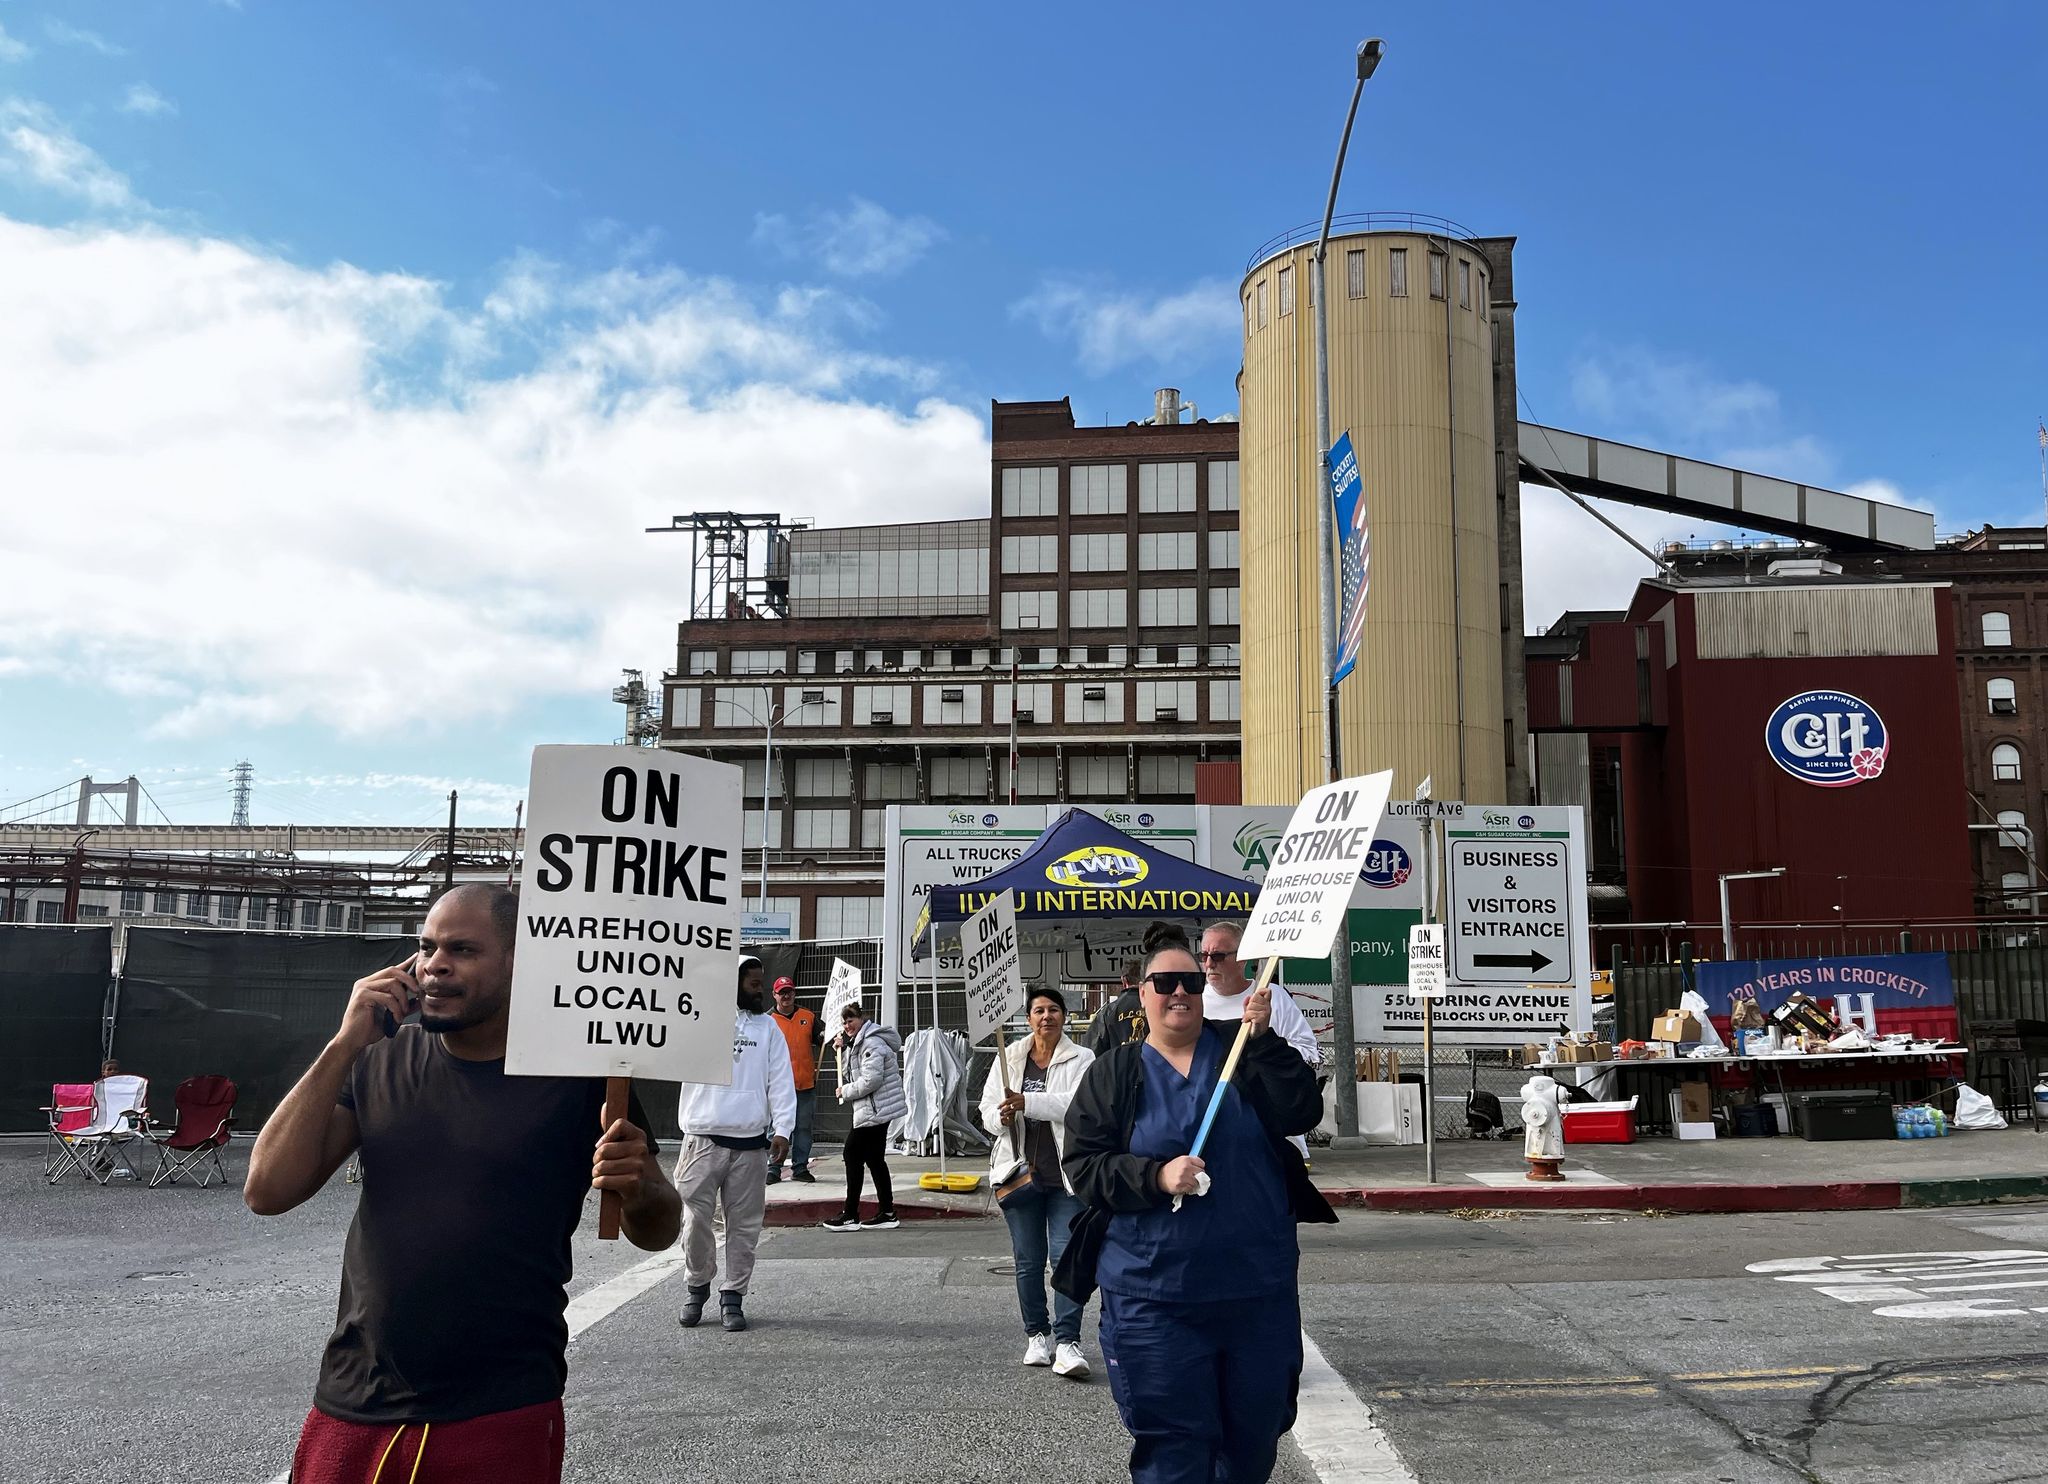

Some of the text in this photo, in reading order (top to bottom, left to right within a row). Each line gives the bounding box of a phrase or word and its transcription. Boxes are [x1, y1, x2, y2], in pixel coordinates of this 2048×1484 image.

[1788, 694, 1860, 710] BAKING HAPPINESS
[1781, 712, 1870, 758] C&H
[601, 766, 680, 828] ON
[1315, 790, 1359, 824] ON
[1387, 802, 1463, 817] Loring Ave
[952, 814, 974, 824] ASR
[1108, 814, 1130, 822] ASR
[1485, 816, 1510, 826] ASR
[926, 848, 1021, 860] ALL TRUCKS
[1278, 826, 1368, 866] STRIKE
[536, 833, 728, 906] STRIKE
[1052, 854, 1142, 881] ILWU
[1463, 852, 1558, 868] BUSINESS
[952, 866, 993, 878] WITH
[1266, 872, 1354, 891] WAREHOUSE
[1504, 875, 1518, 890] &
[1037, 890, 1254, 912] INTERNATIONAL
[1276, 891, 1323, 906] UNION
[1467, 898, 1557, 914] VISITORS
[978, 908, 998, 942] ON
[1261, 910, 1323, 926] LOCAL 6,
[527, 916, 733, 951] WAREHOUSE
[1266, 928, 1302, 942] ILWU
[1418, 930, 1430, 942] ON
[1461, 922, 1565, 938] ENTRANCE
[968, 926, 1014, 980] STRIKE
[1410, 945, 1442, 959] STRIKE
[577, 950, 684, 979] UNION
[968, 954, 1017, 998] WAREHOUSE
[1726, 966, 1928, 1001] 120 YEARS IN CROCKETT
[836, 980, 848, 996] ON
[982, 974, 1008, 1002] UNION
[553, 984, 701, 1020] LOCAL 6,
[828, 986, 859, 1014] STRIKE
[978, 985, 1014, 1018] LOCAL 6,
[1384, 994, 1570, 1008] 550 ORING AVENUE
[988, 1002, 1007, 1023] ILWU
[1433, 1012, 1486, 1022] BLOCKS
[1489, 1012, 1510, 1023] UP,
[1512, 1012, 1534, 1022] ON
[1538, 1012, 1569, 1022] LEFT
[587, 1020, 667, 1048] ILWU
